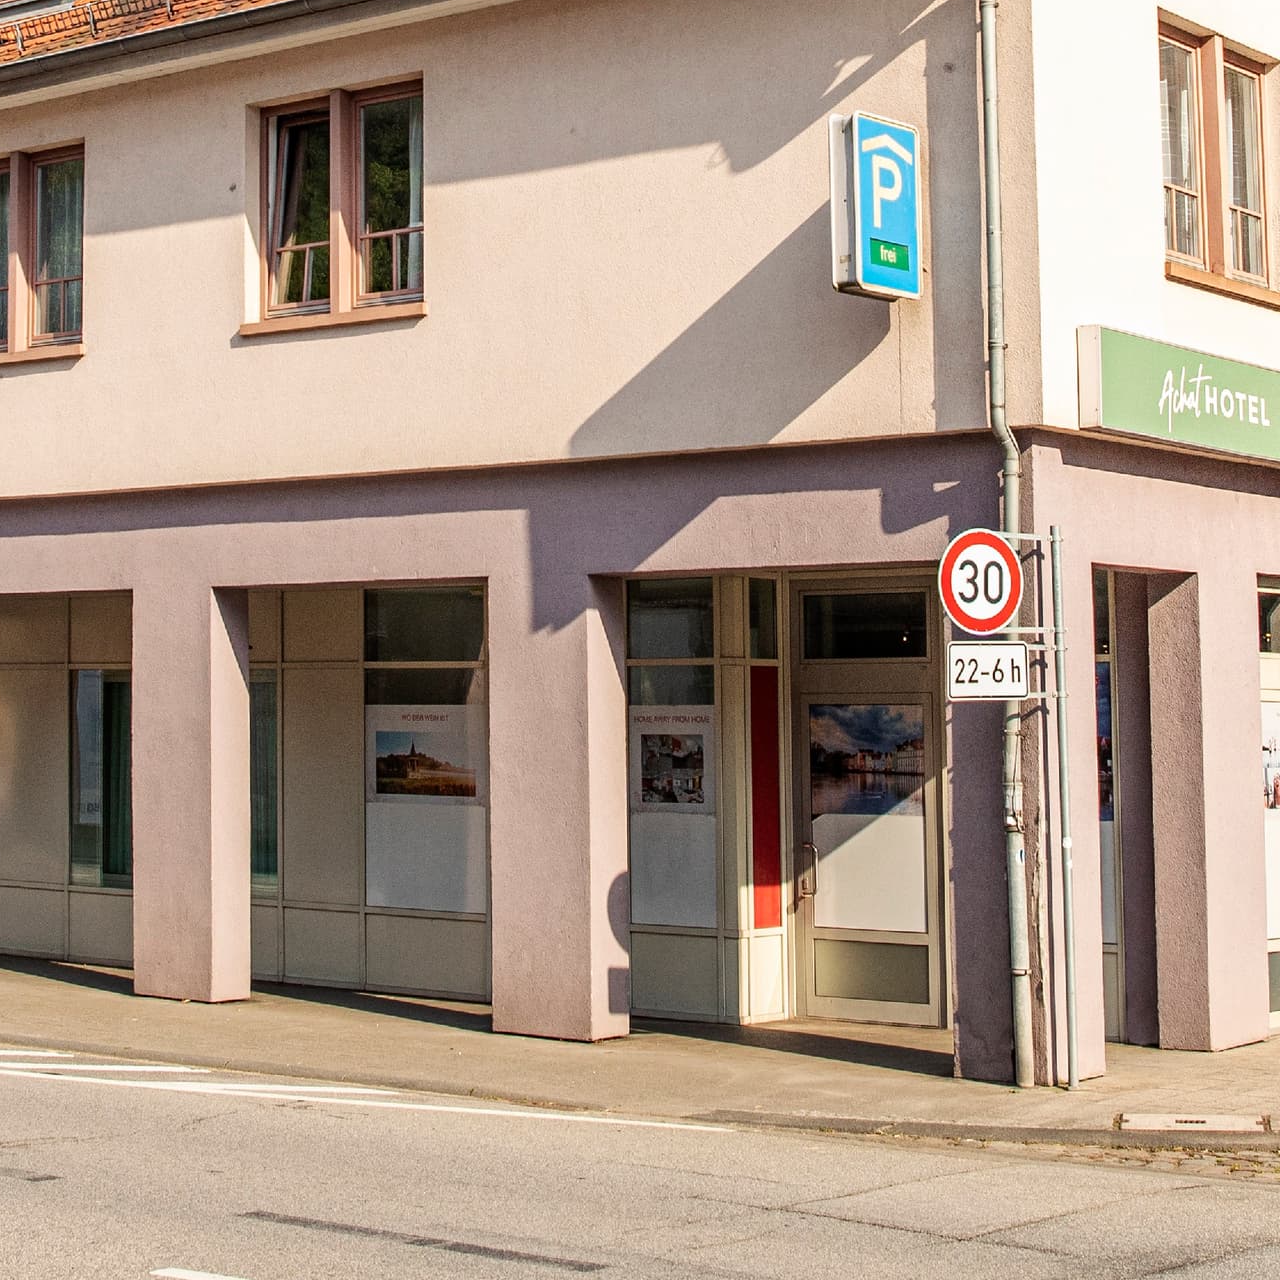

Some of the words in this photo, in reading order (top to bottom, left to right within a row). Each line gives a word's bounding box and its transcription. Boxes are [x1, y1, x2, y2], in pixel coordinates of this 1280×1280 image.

[871, 153, 902, 228] P
[880, 244, 897, 263] frei
[1158, 363, 1212, 432] Achat
[1204, 384, 1271, 427] HOTEL
[958, 559, 1003, 604] 30
[954, 658, 1005, 683] 22-6
[1011, 658, 1021, 683] h
